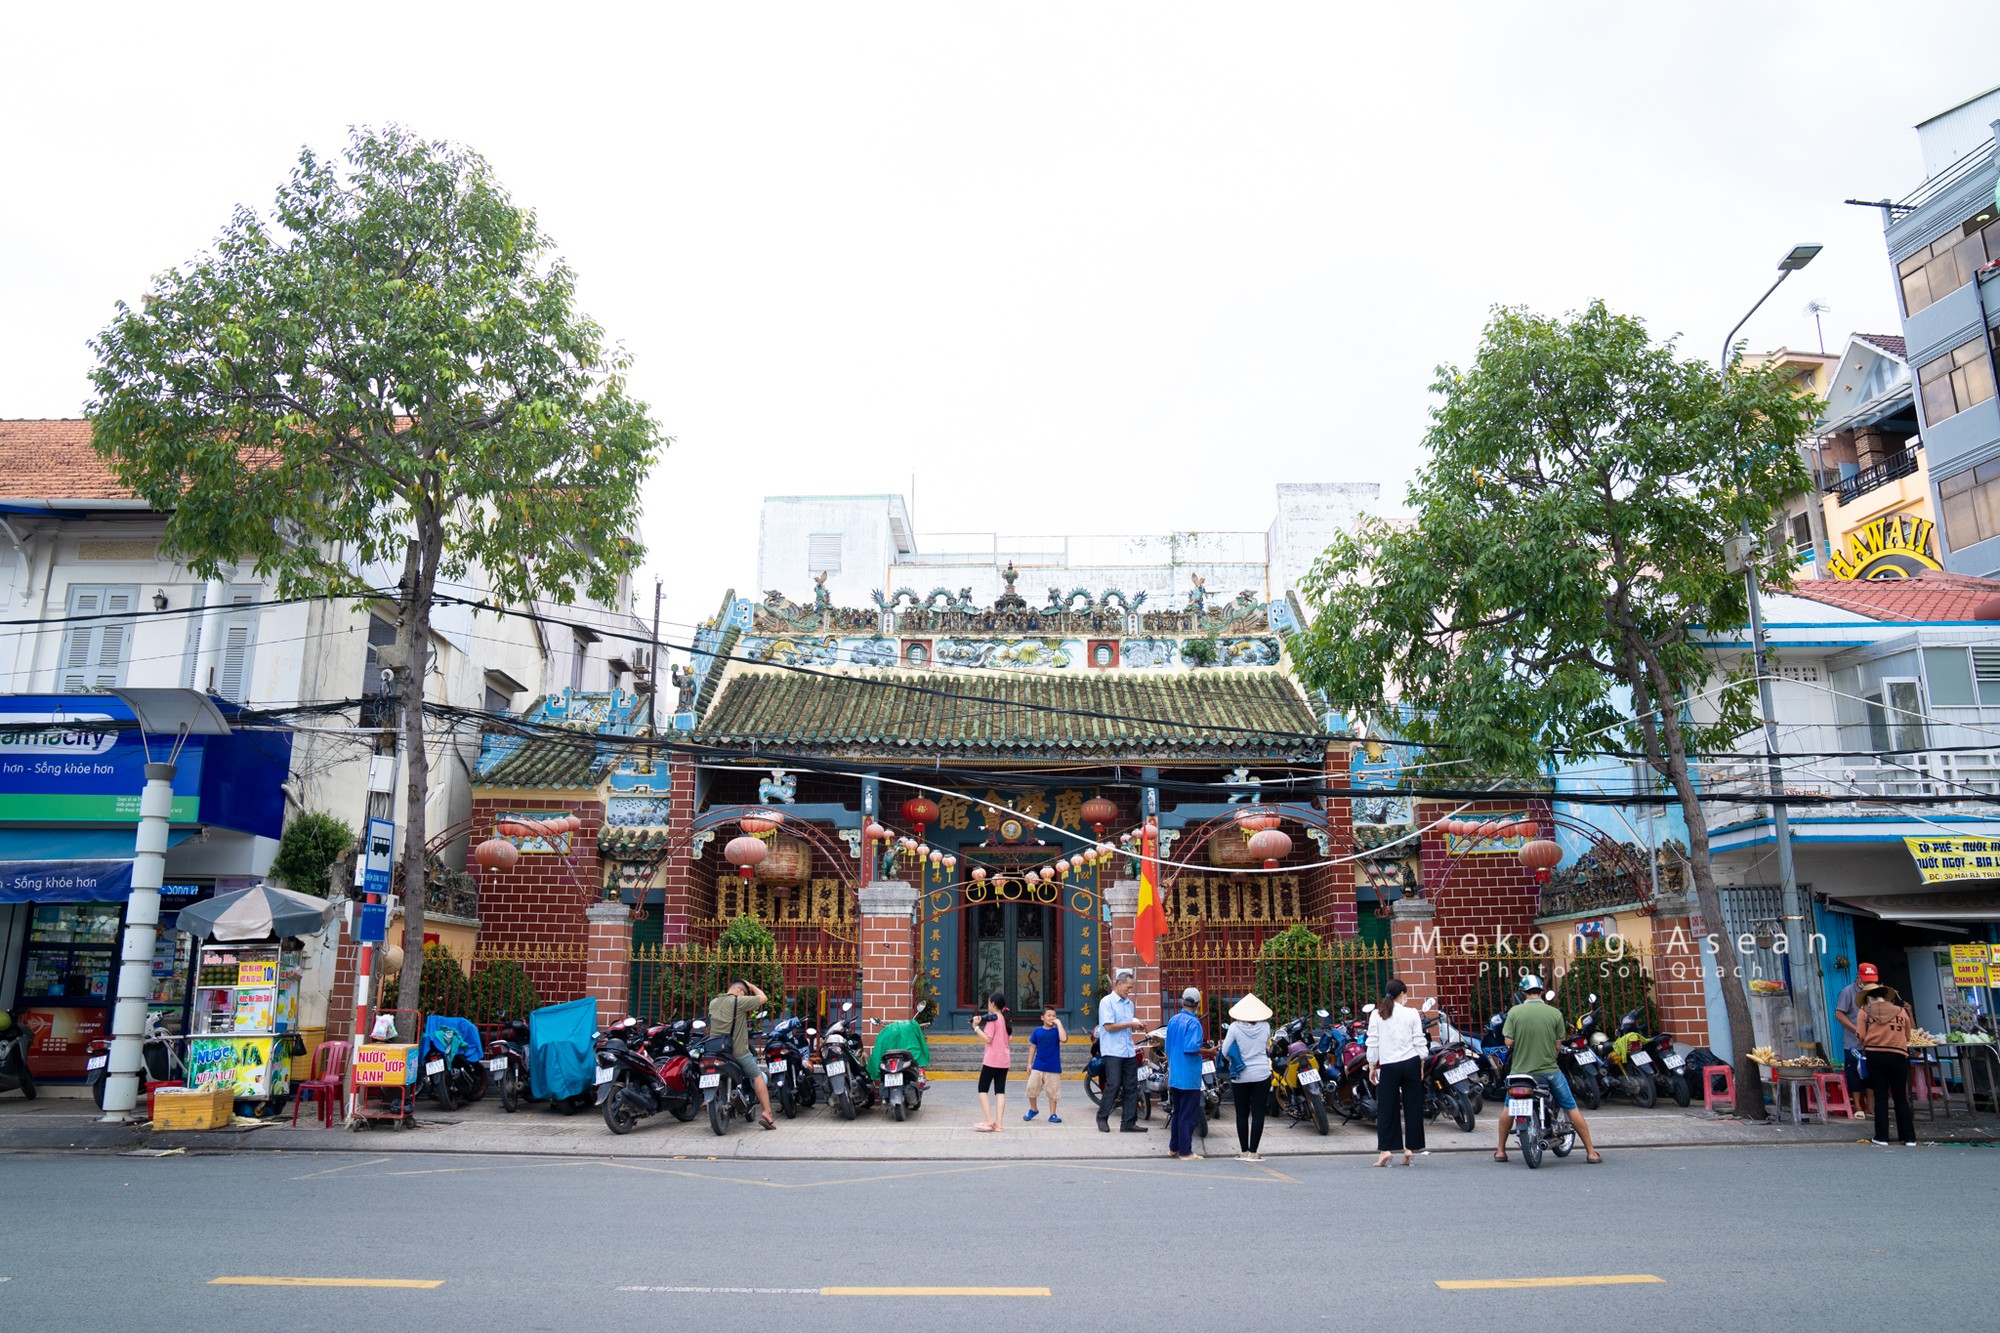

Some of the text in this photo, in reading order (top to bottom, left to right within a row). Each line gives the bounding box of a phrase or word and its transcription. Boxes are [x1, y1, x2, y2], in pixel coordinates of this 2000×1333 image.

[1826, 516, 1934, 579] HAWAII
[35, 761, 60, 776] Sống
[64, 762, 90, 774] khỏe
[93, 763, 114, 774] hơn
[1976, 856, 1992, 868] BIA
[14, 876, 42, 890] Sống
[46, 876, 73, 888] khỏe
[76, 876, 97, 888] hơn
[197, 1046, 231, 1064] NƯỚC
[358, 1050, 386, 1063] NƯỚC
[385, 1059, 406, 1072] ƯỚP
[356, 1070, 384, 1084] LẠNH
